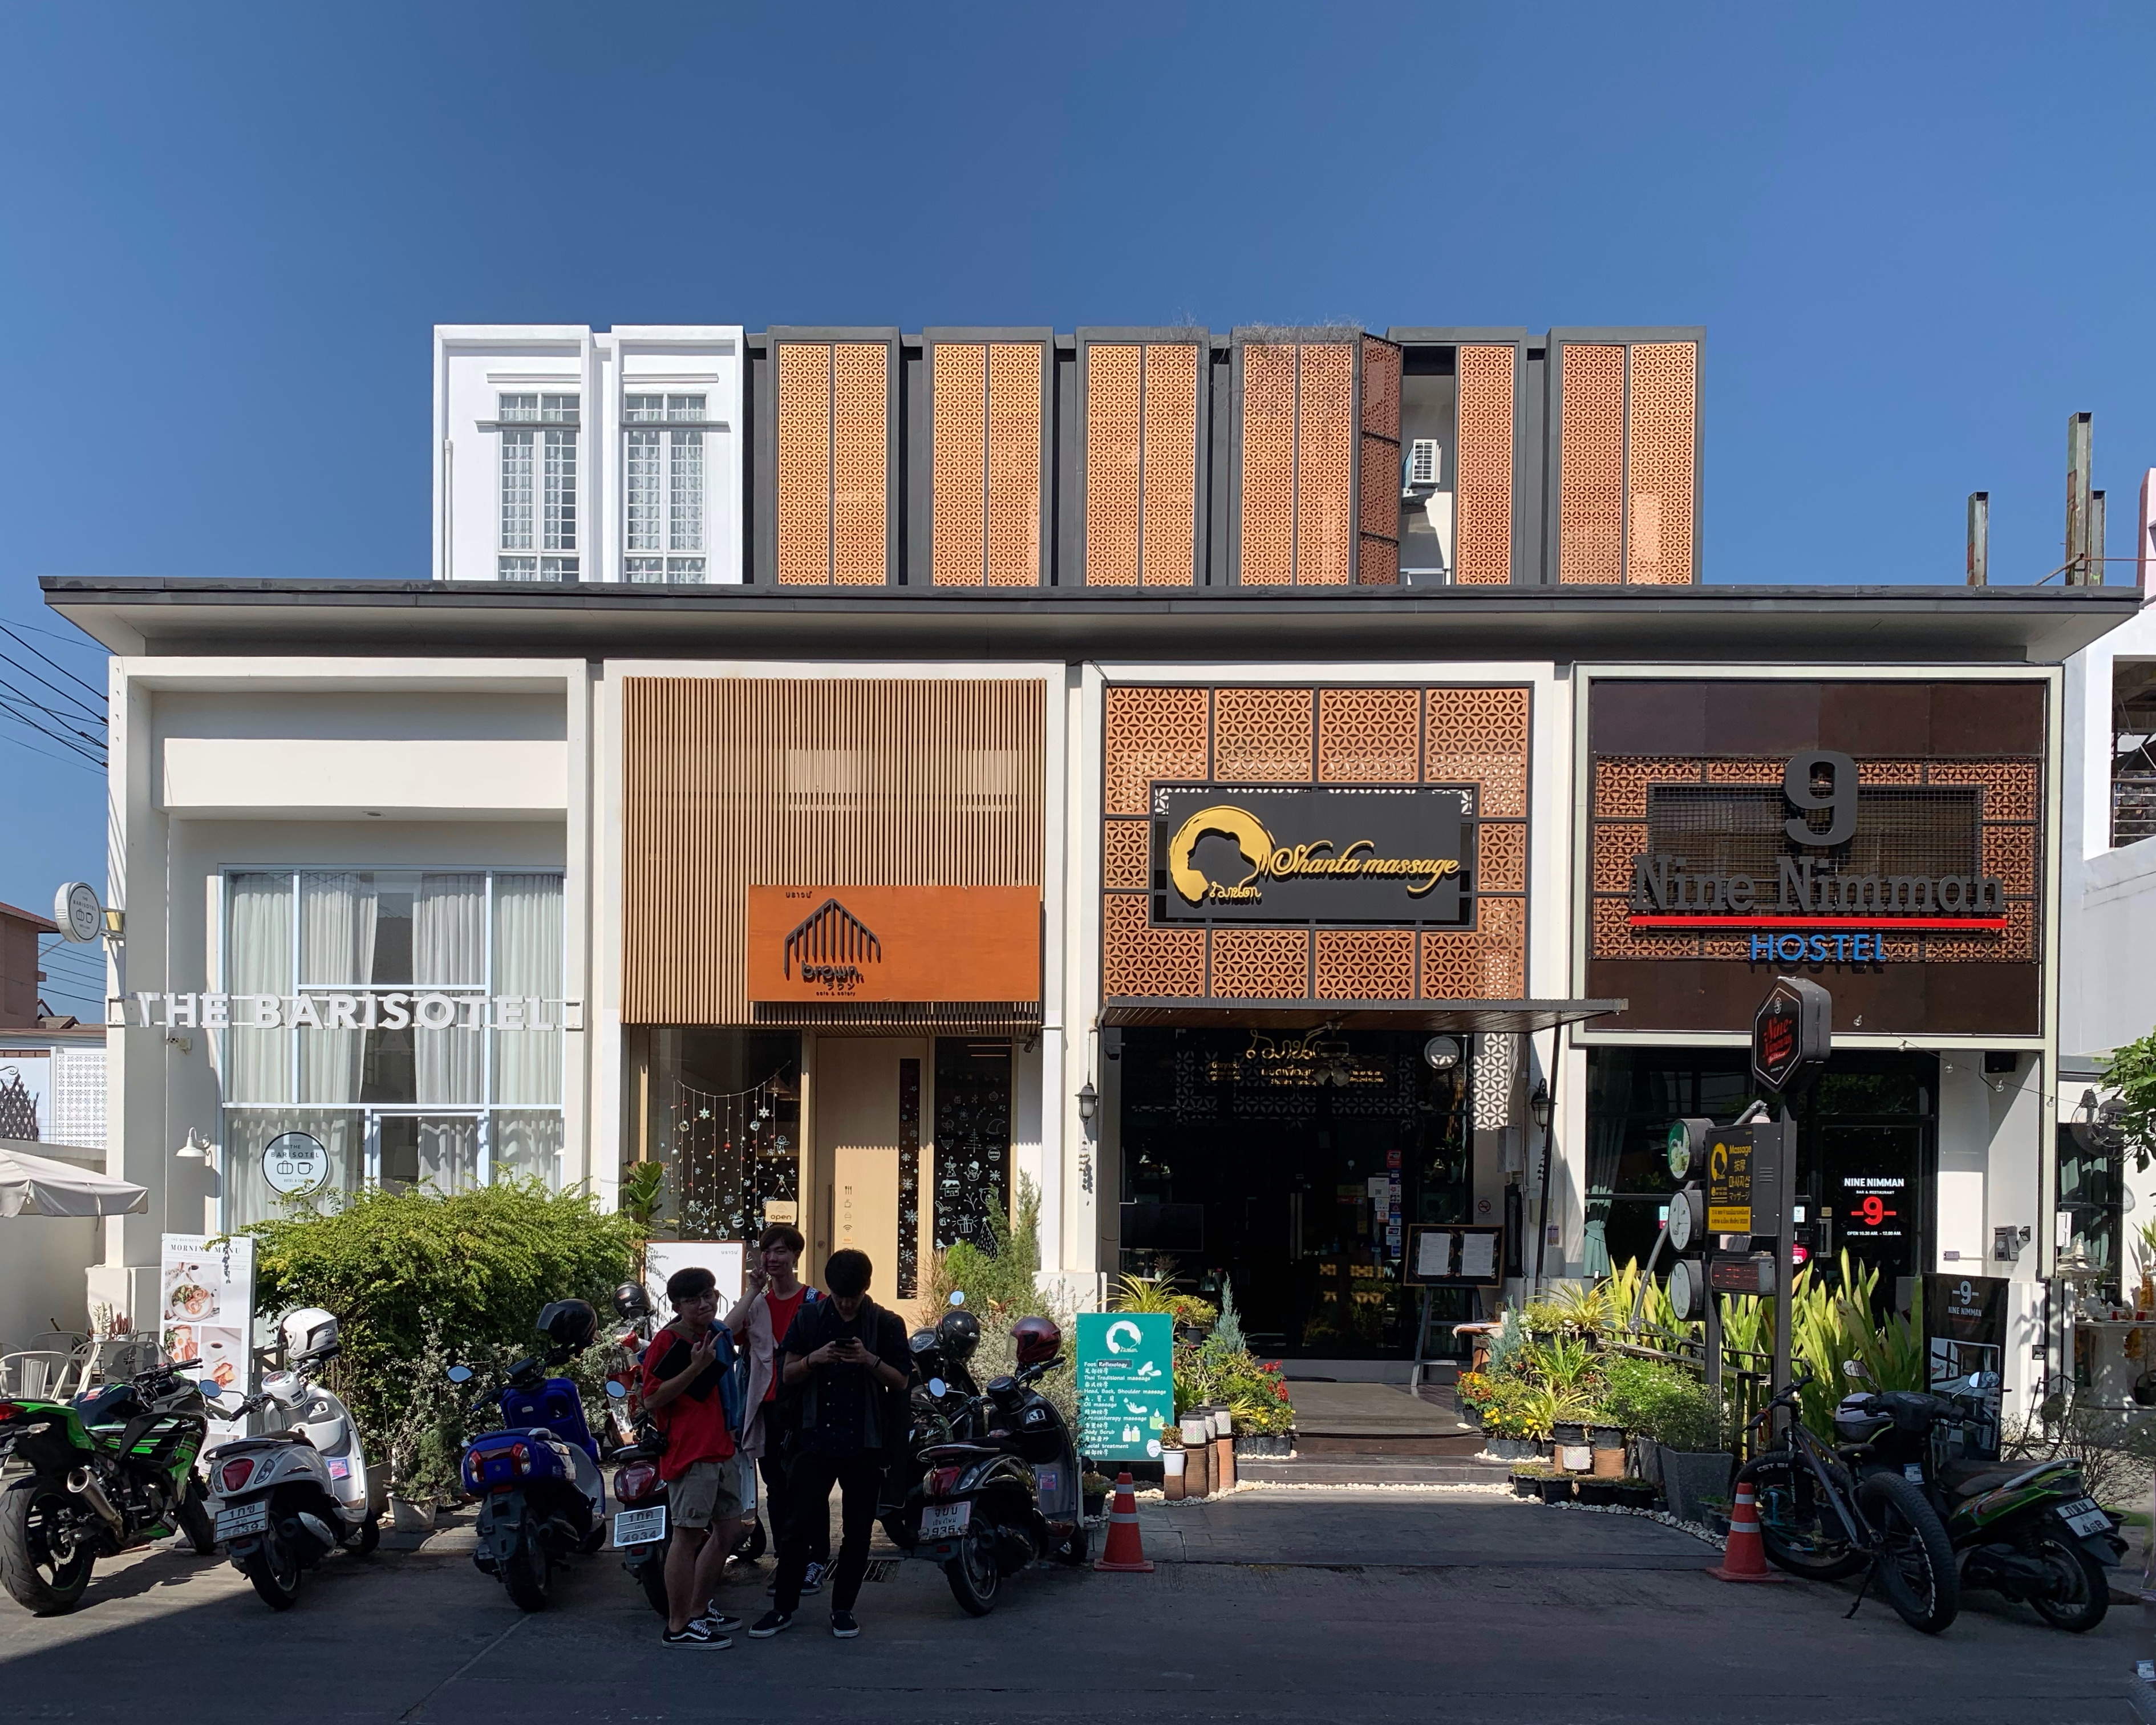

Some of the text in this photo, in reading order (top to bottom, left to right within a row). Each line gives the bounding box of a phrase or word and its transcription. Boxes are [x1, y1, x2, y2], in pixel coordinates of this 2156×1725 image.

[1784, 750, 1858, 845] 9
[1270, 840, 1460, 893] Shanta massage
[1632, 855, 2005, 912] Nine Nimman
[73, 900, 96, 911] BARISOTEL
[1750, 933, 1886, 961] HOSTEL
[136, 993, 556, 1030] THE BARISOTEL
[1729, 1144, 1752, 1157] Massage
[1844, 1178, 1904, 1187] NINE NIMMAN
[1863, 1196, 1883, 1225] 9
[171, 1244, 209, 1253] MORNIN
[1960, 1281, 1972, 1305] 9
[1948, 1306, 1982, 1317] NINE NIMMAN
[1756, 1463, 1775, 1472] CST
[622, 1530, 656, 1542] 4934
